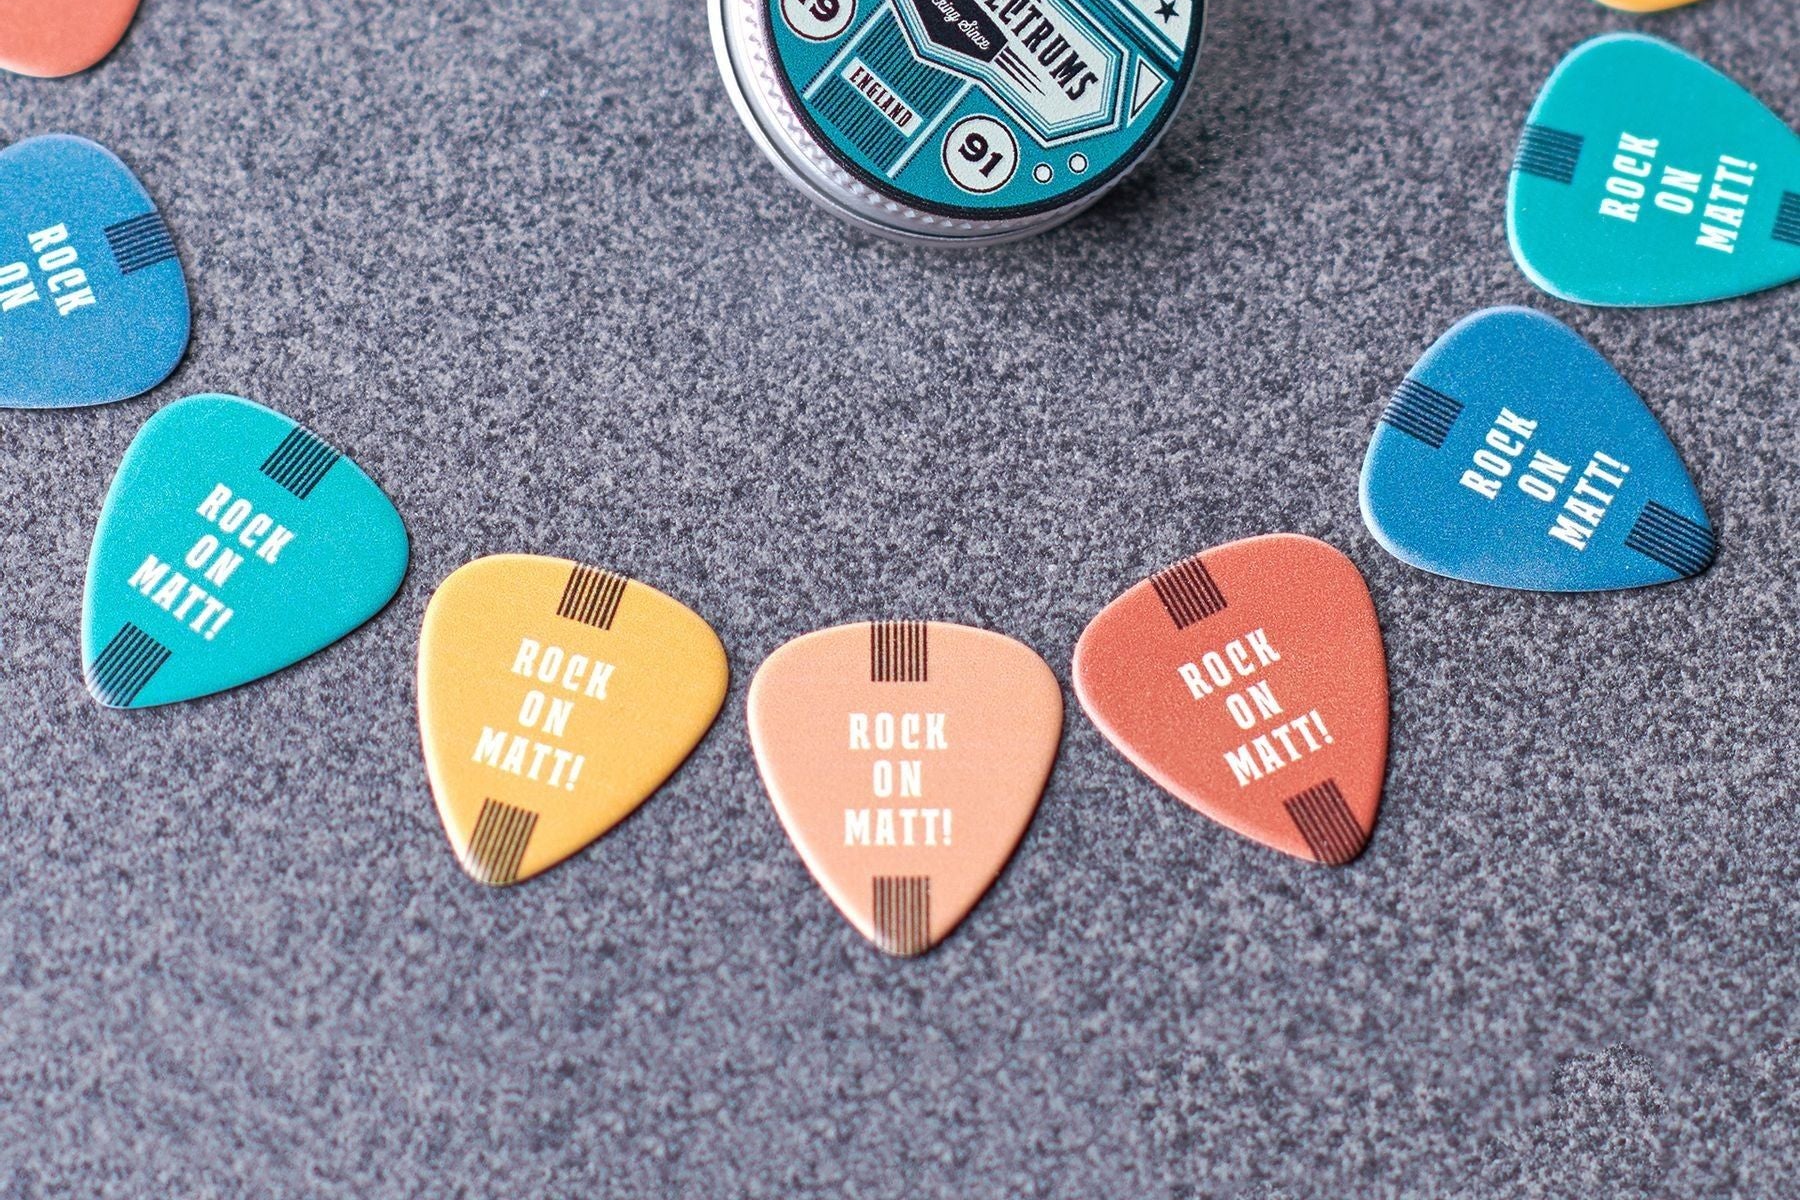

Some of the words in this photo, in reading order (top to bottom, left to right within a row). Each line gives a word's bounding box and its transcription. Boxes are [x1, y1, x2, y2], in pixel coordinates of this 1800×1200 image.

[957, 18, 990, 50] Since
[849, 66, 914, 128] ENGLAND
[958, 132, 1004, 178] 91
[1598, 133, 1659, 222] ROCK
[1654, 165, 1702, 214] ON
[1696, 155, 1758, 254] MATT!
[27, 222, 96, 317] ROCK
[1459, 407, 1538, 499] ROCK
[1518, 450, 1572, 502] ON
[195, 482, 294, 566] ROCK
[1548, 451, 1630, 551] MATT!
[184, 534, 243, 585] ON
[127, 554, 235, 642] MATT!
[511, 637, 616, 702] ROCK
[1177, 628, 1282, 700] ROCK
[518, 690, 573, 737] ON
[848, 713, 947, 750] ROCK
[1225, 680, 1283, 730] ON
[471, 726, 586, 791] MATT!
[872, 760, 922, 798] ON
[1222, 712, 1334, 787] MATT!
[844, 808, 953, 847] MATT!
